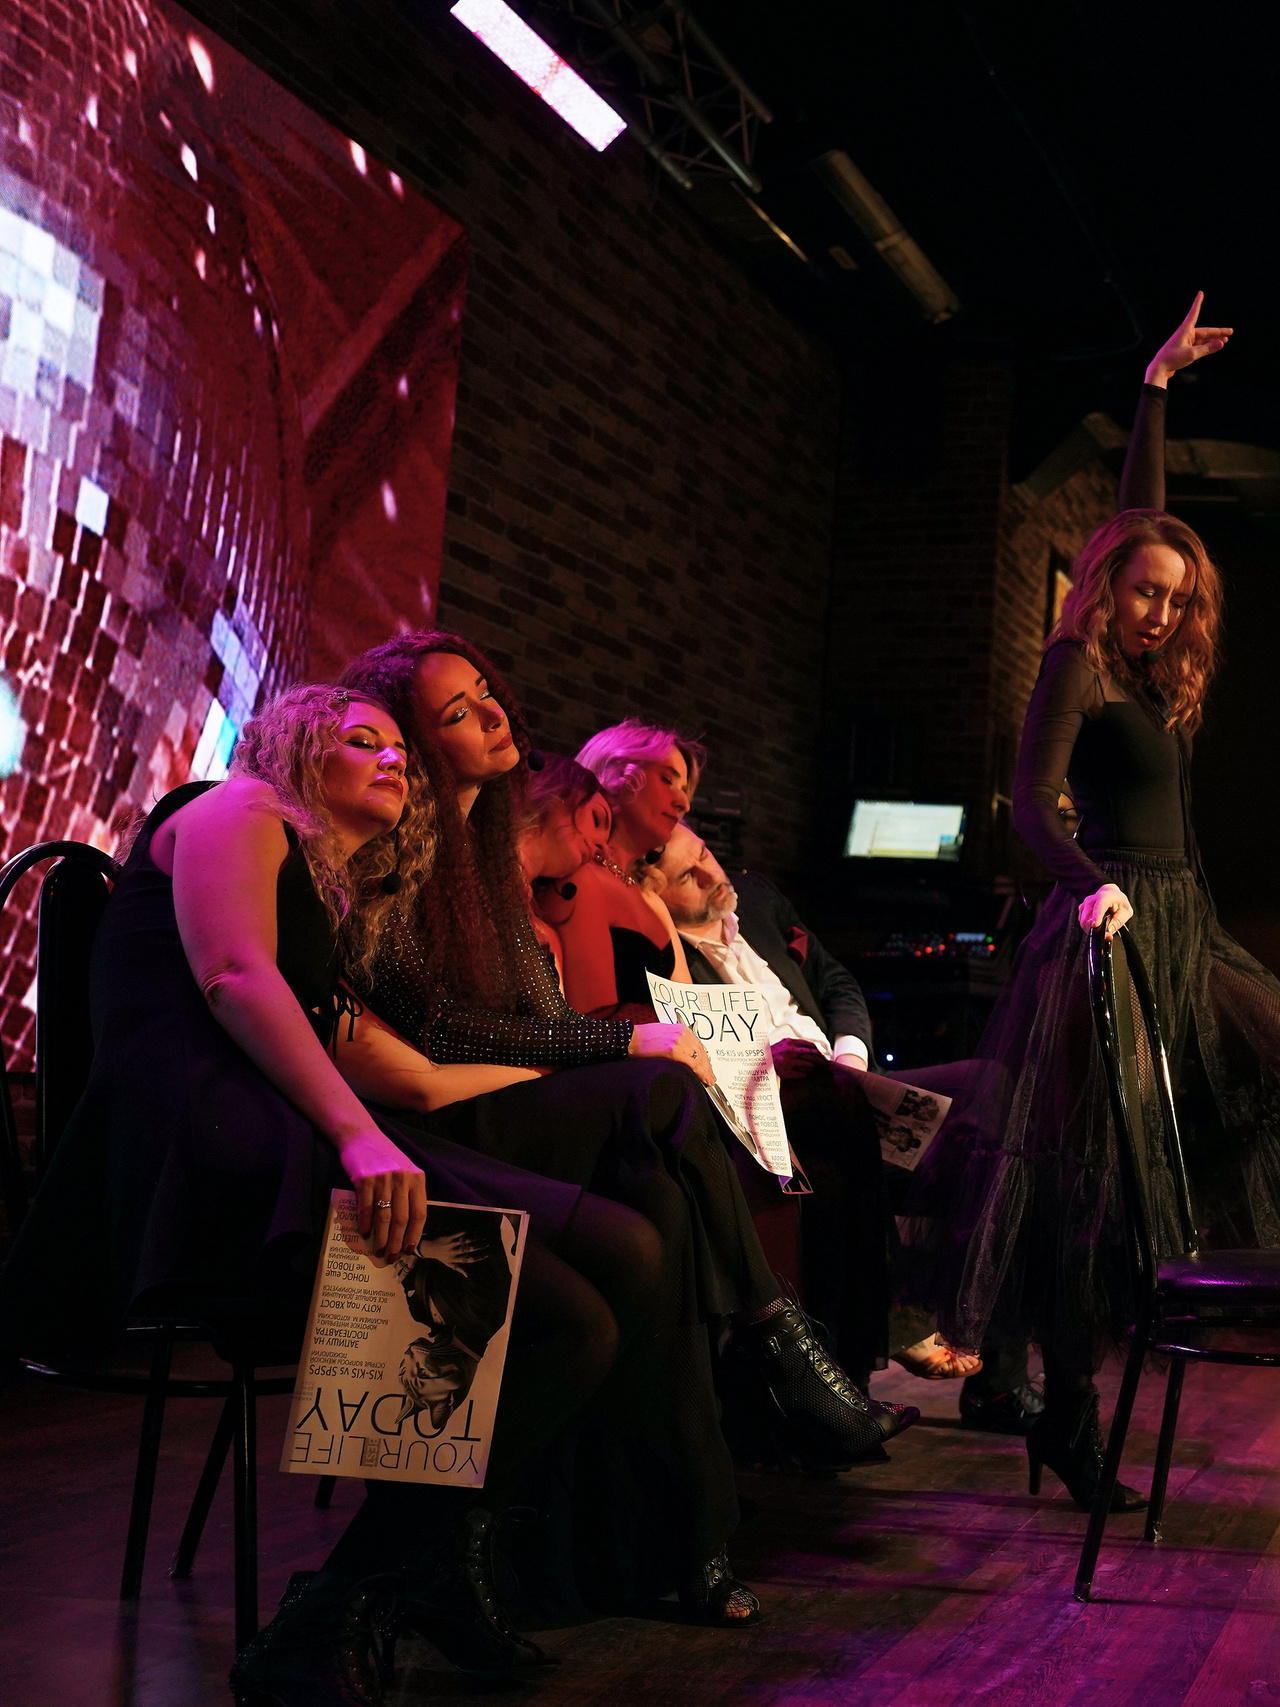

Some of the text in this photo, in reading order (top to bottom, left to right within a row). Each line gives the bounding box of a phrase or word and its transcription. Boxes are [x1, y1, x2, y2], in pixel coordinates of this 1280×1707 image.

[650, 981, 759, 1012] YOUR LIFE
[745, 1049, 765, 1057] SPSPS
[332, 1233, 359, 1243] ШЕПОТ
[327, 1259, 355, 1271] ПОВОД
[325, 1270, 370, 1283] ПОНОС еще
[323, 1285, 362, 1294] ИГНОРИРУЕТСЯ
[321, 1291, 355, 1300] ДОМАШНИХ
[320, 1299, 382, 1313] КОТУ под ХВОСТ
[321, 1320, 349, 1328] ИНТЕРВЬЮ
[350, 1322, 377, 1330] КОРОТКОЕ
[359, 1317, 389, 1325] ВАСИЛИЕМ
[315, 1327, 369, 1340] ПОСЛЕЗАВТРА
[326, 1338, 359, 1348] ЗАПИШУ
[310, 1350, 348, 1358] ПСИХОЛОГИИ
[310, 1356, 337, 1364] ЖЕНСКОЙ
[337, 1359, 363, 1367] ВОПРОСЫ
[309, 1364, 383, 1380] KIS-KIS vs SPSPS
[296, 1387, 481, 1442] TODAY
[289, 1432, 478, 1474] YOUR LIFE
